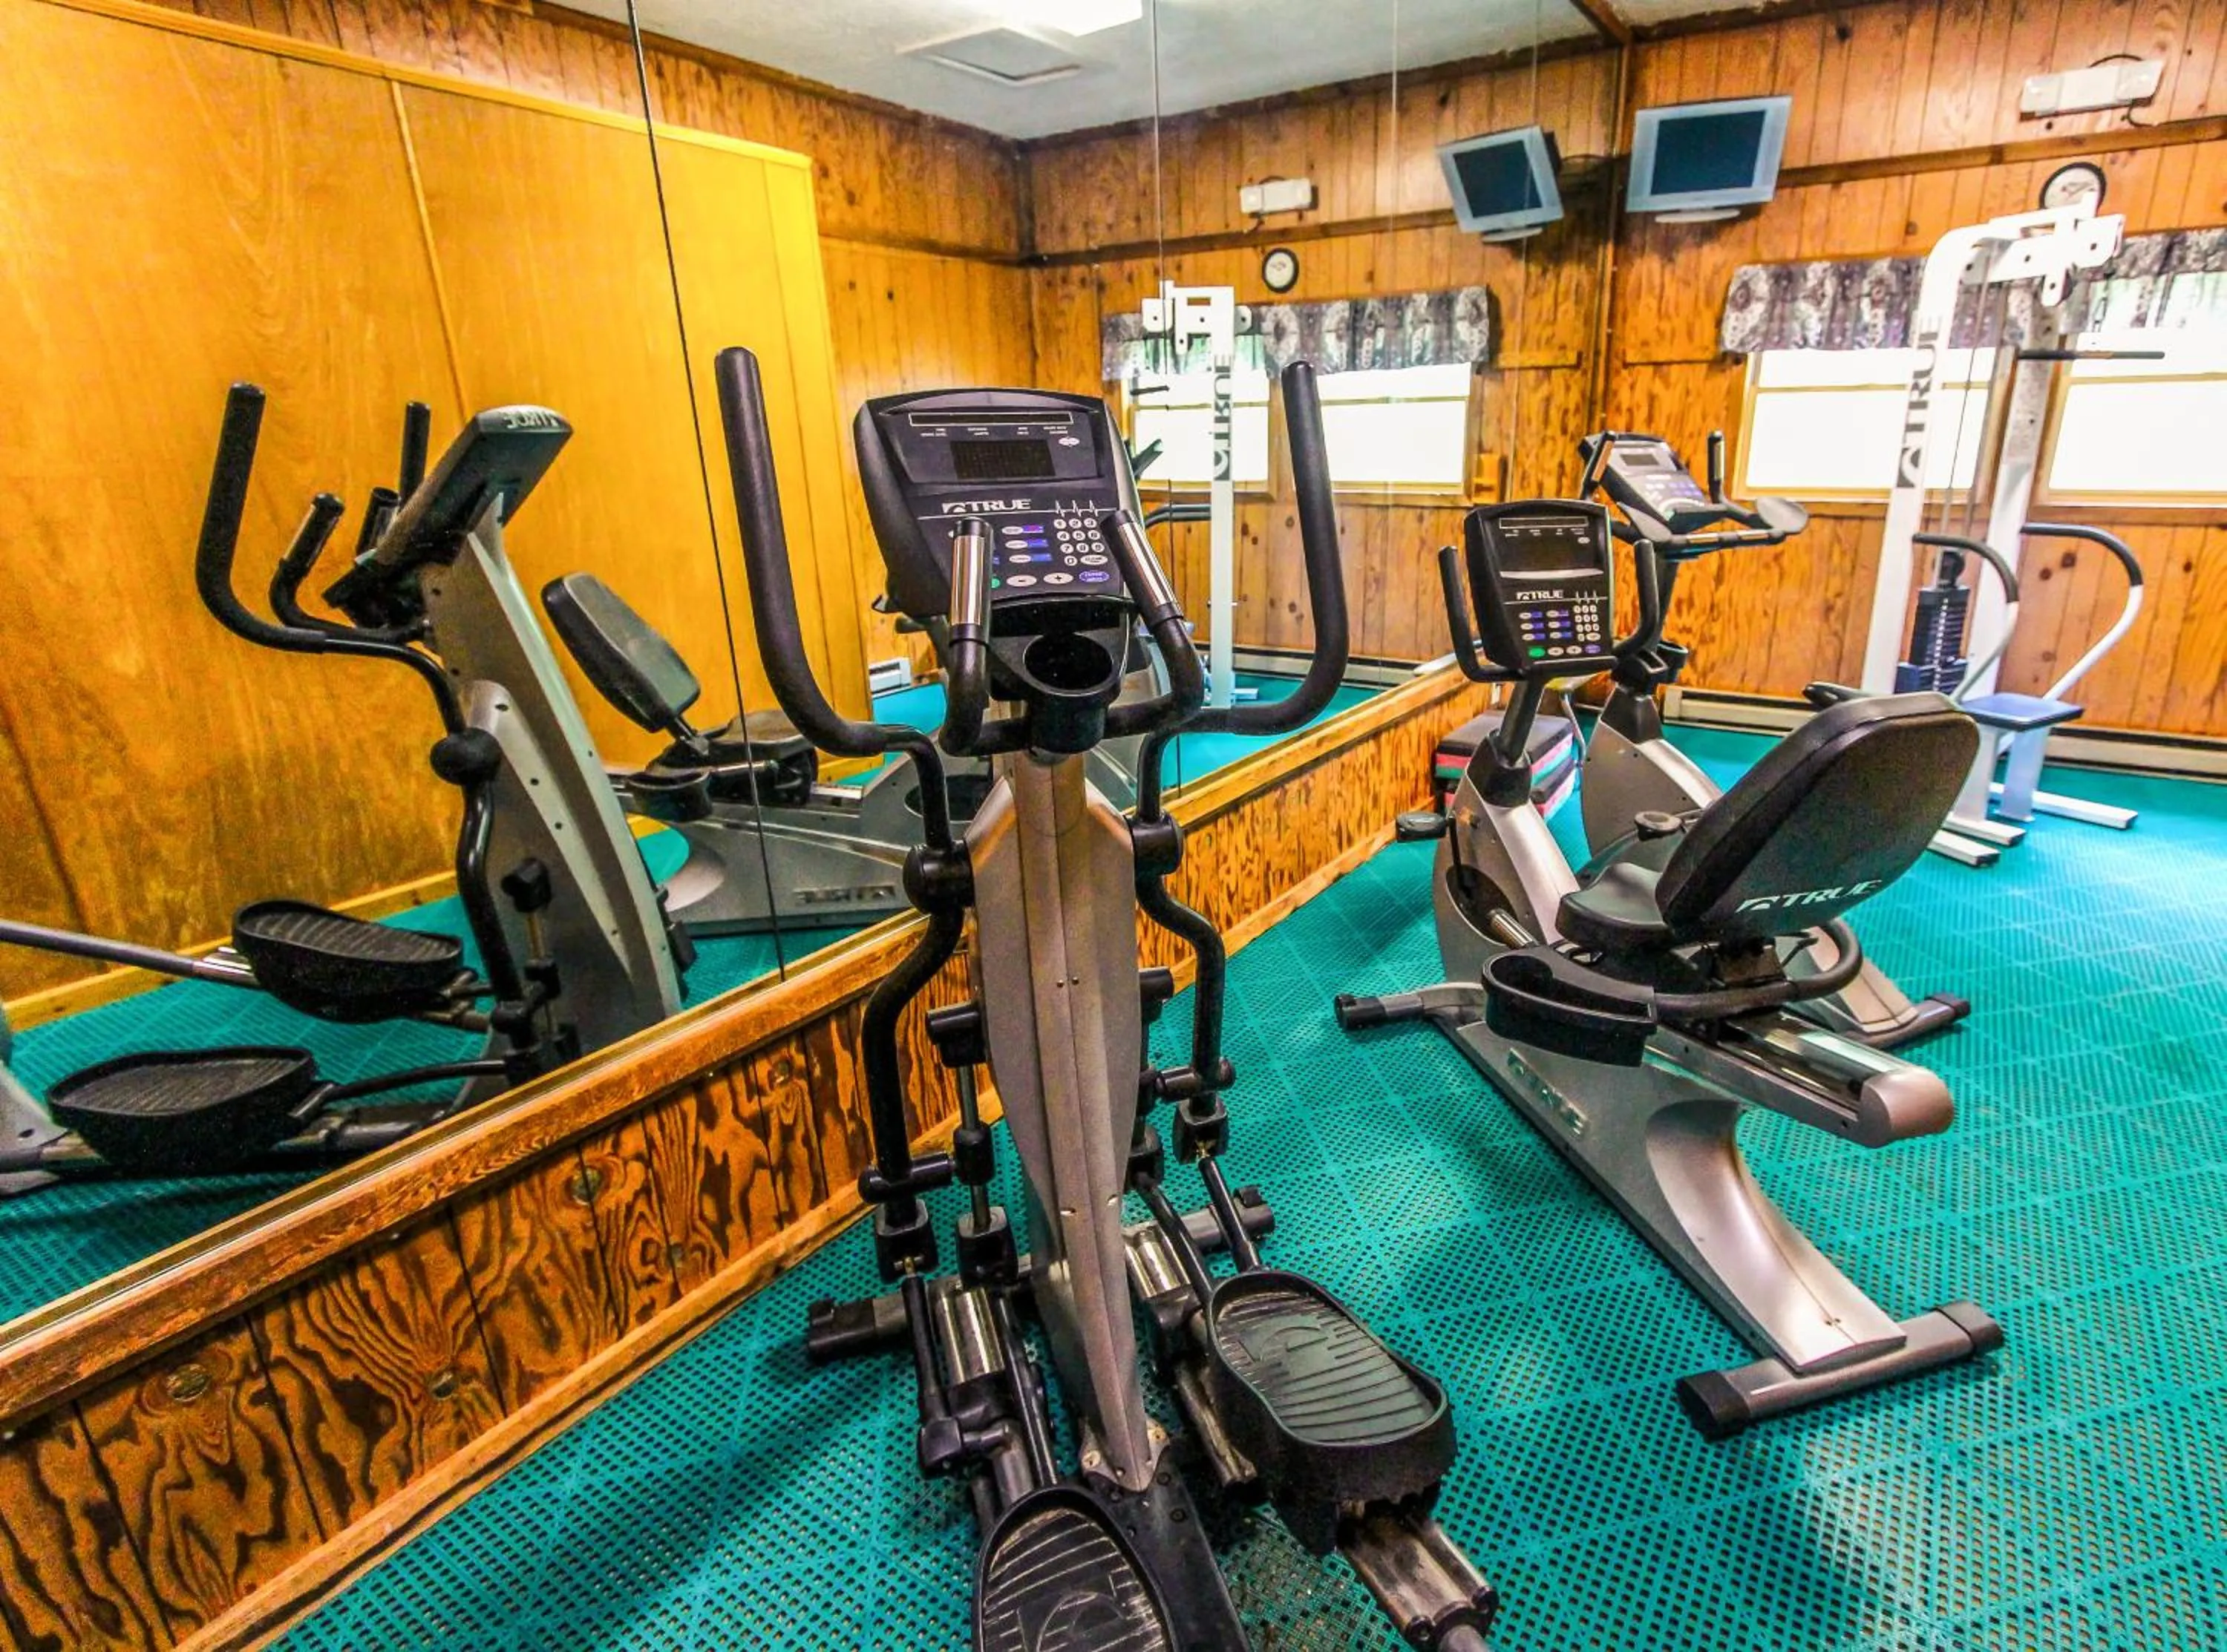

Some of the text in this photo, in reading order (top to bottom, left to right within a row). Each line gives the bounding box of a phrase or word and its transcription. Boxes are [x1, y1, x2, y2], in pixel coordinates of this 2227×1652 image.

[1902, 316, 1942, 444] TRUE
[964, 499, 1032, 511] TRUE
[1530, 589, 1564, 600] TRUE
[1781, 879, 1883, 907] TRUE
